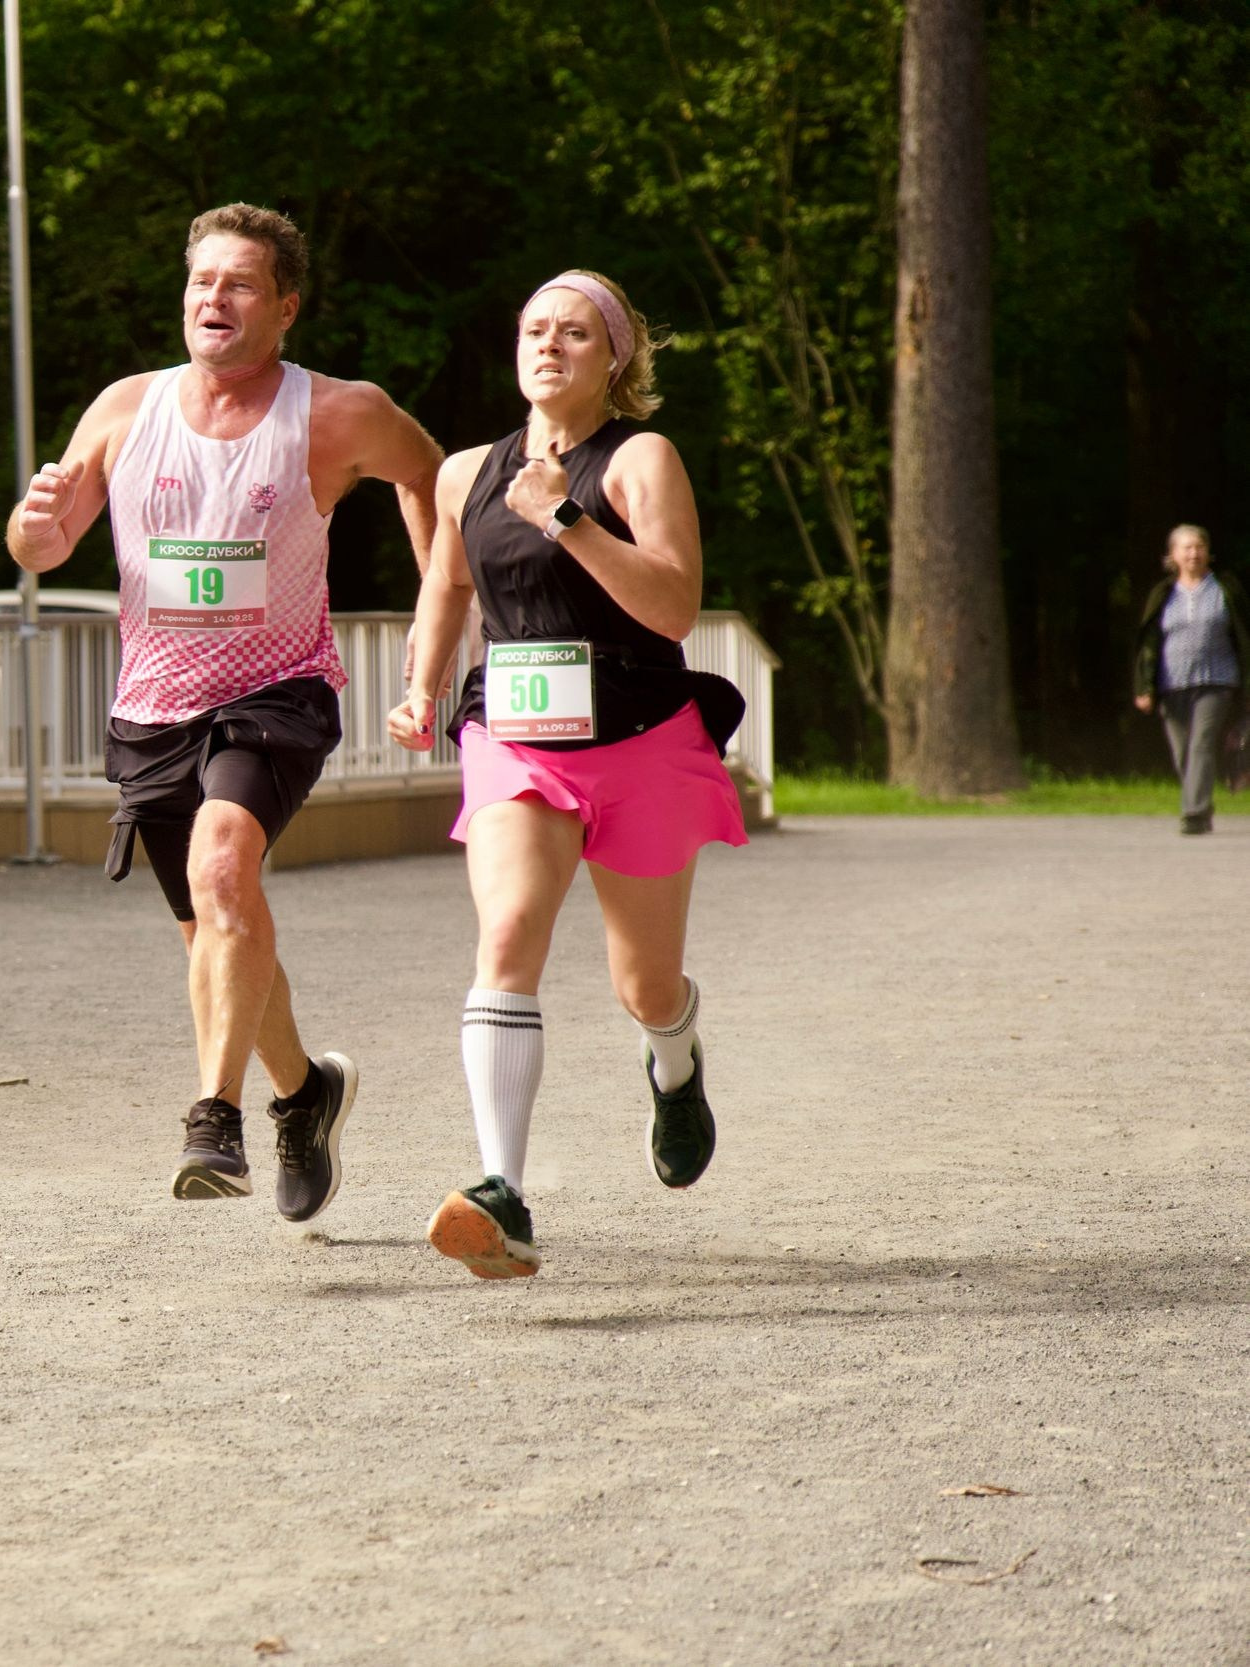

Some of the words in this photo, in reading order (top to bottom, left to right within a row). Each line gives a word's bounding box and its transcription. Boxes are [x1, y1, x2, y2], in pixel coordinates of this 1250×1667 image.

[159, 544, 205, 557] КРОСС
[206, 546, 254, 559] ДУБКИ
[184, 567, 224, 605] 19
[158, 613, 204, 623] Апрелевка
[213, 613, 254, 624] 14.09.25
[529, 650, 576, 664] ДУБКИ
[510, 673, 549, 713] 50
[536, 723, 580, 733] 14.09.25
